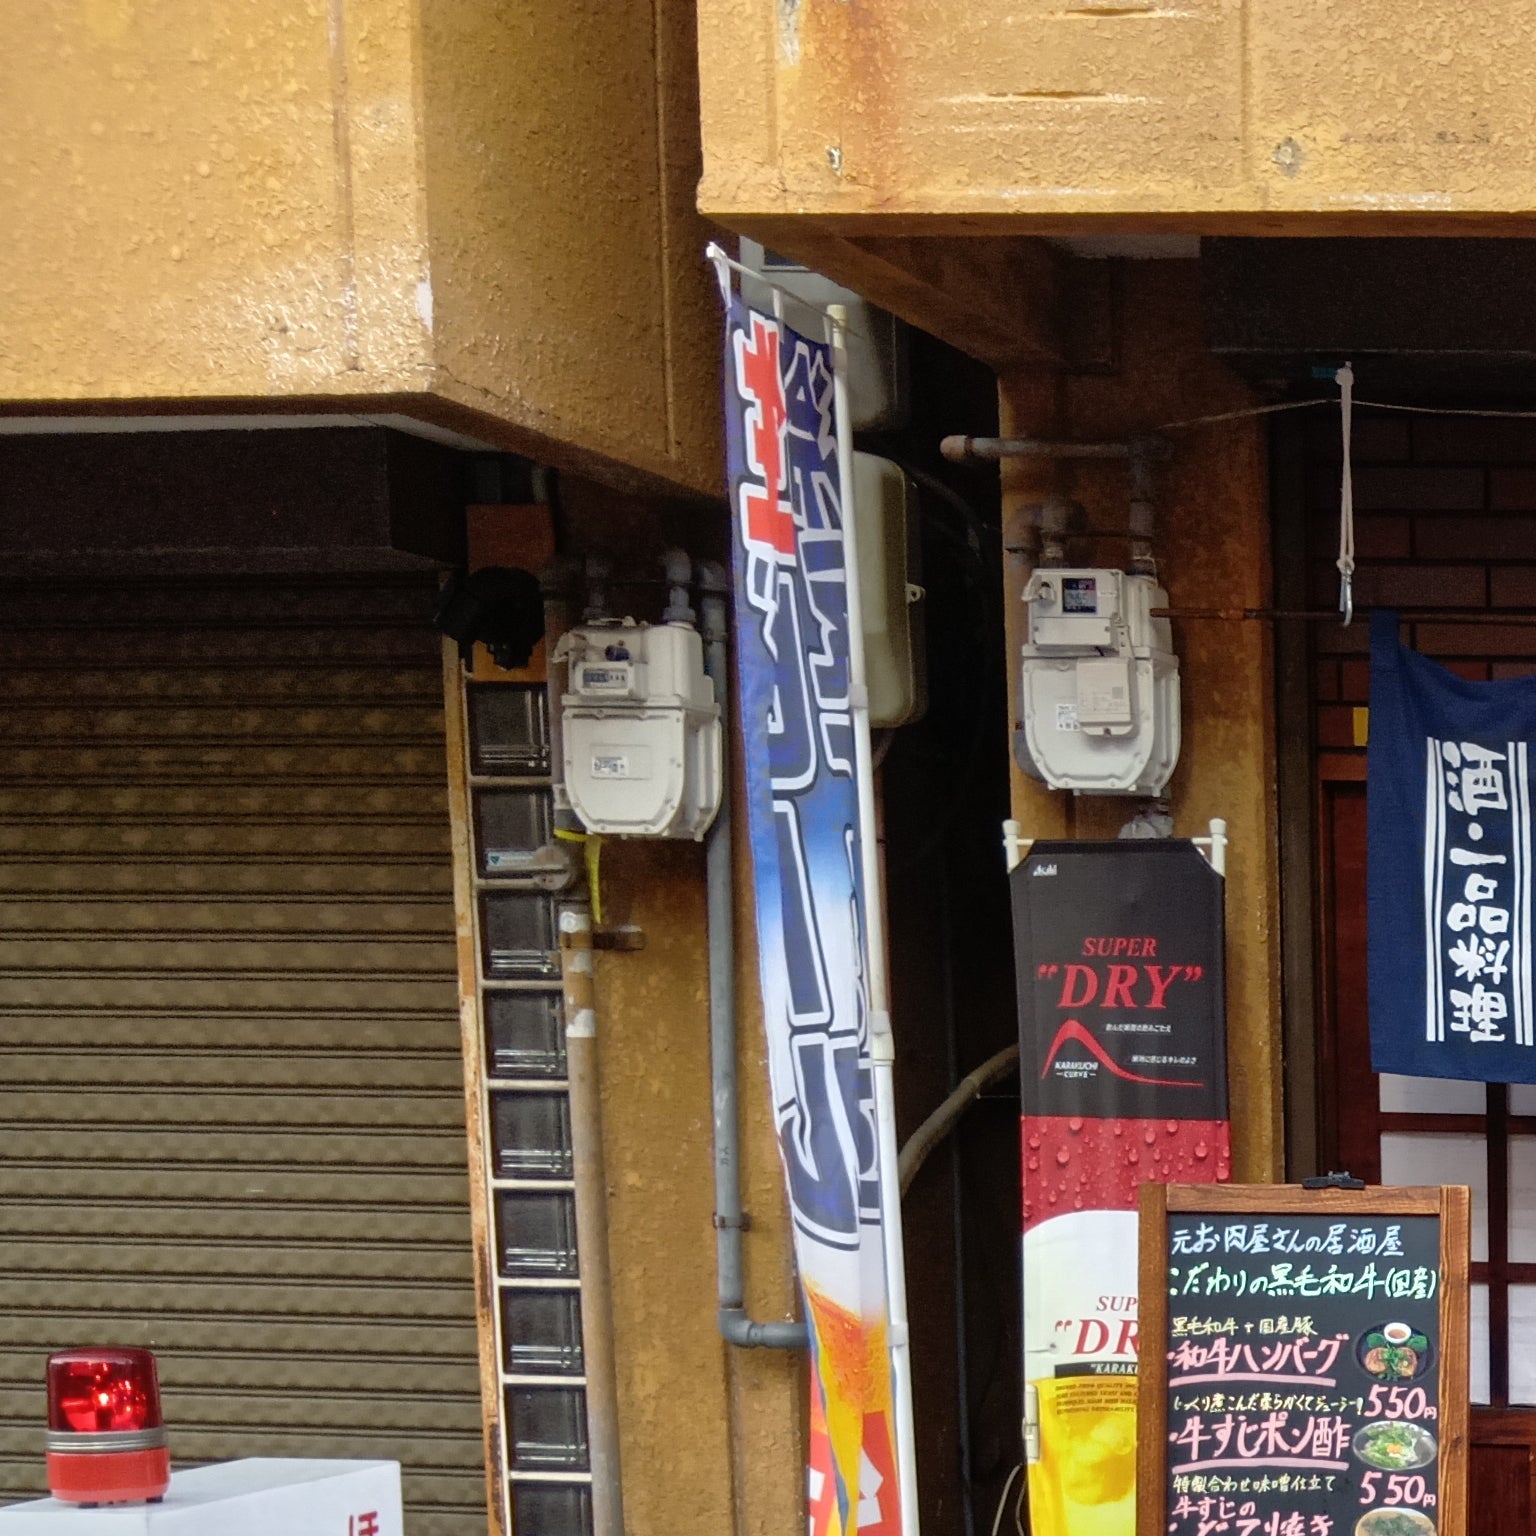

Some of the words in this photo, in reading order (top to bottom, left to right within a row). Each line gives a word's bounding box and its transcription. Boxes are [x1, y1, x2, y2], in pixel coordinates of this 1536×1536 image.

[1033, 865, 1057, 876] Asahi
[1082, 937, 1157, 957] SUPER
[1171, 1223, 1405, 1257] 元お肉屋さんの居酒屋
[1096, 1296, 1138, 1312] SUP
[1055, 1318, 1138, 1355] “DR
[1171, 1317, 1238, 1338] 黒毛和牛
[1364, 1384, 1437, 1419] 550円
[1360, 1471, 1436, 1507] 550円
[1172, 1495, 1256, 1520] 牛すじの
